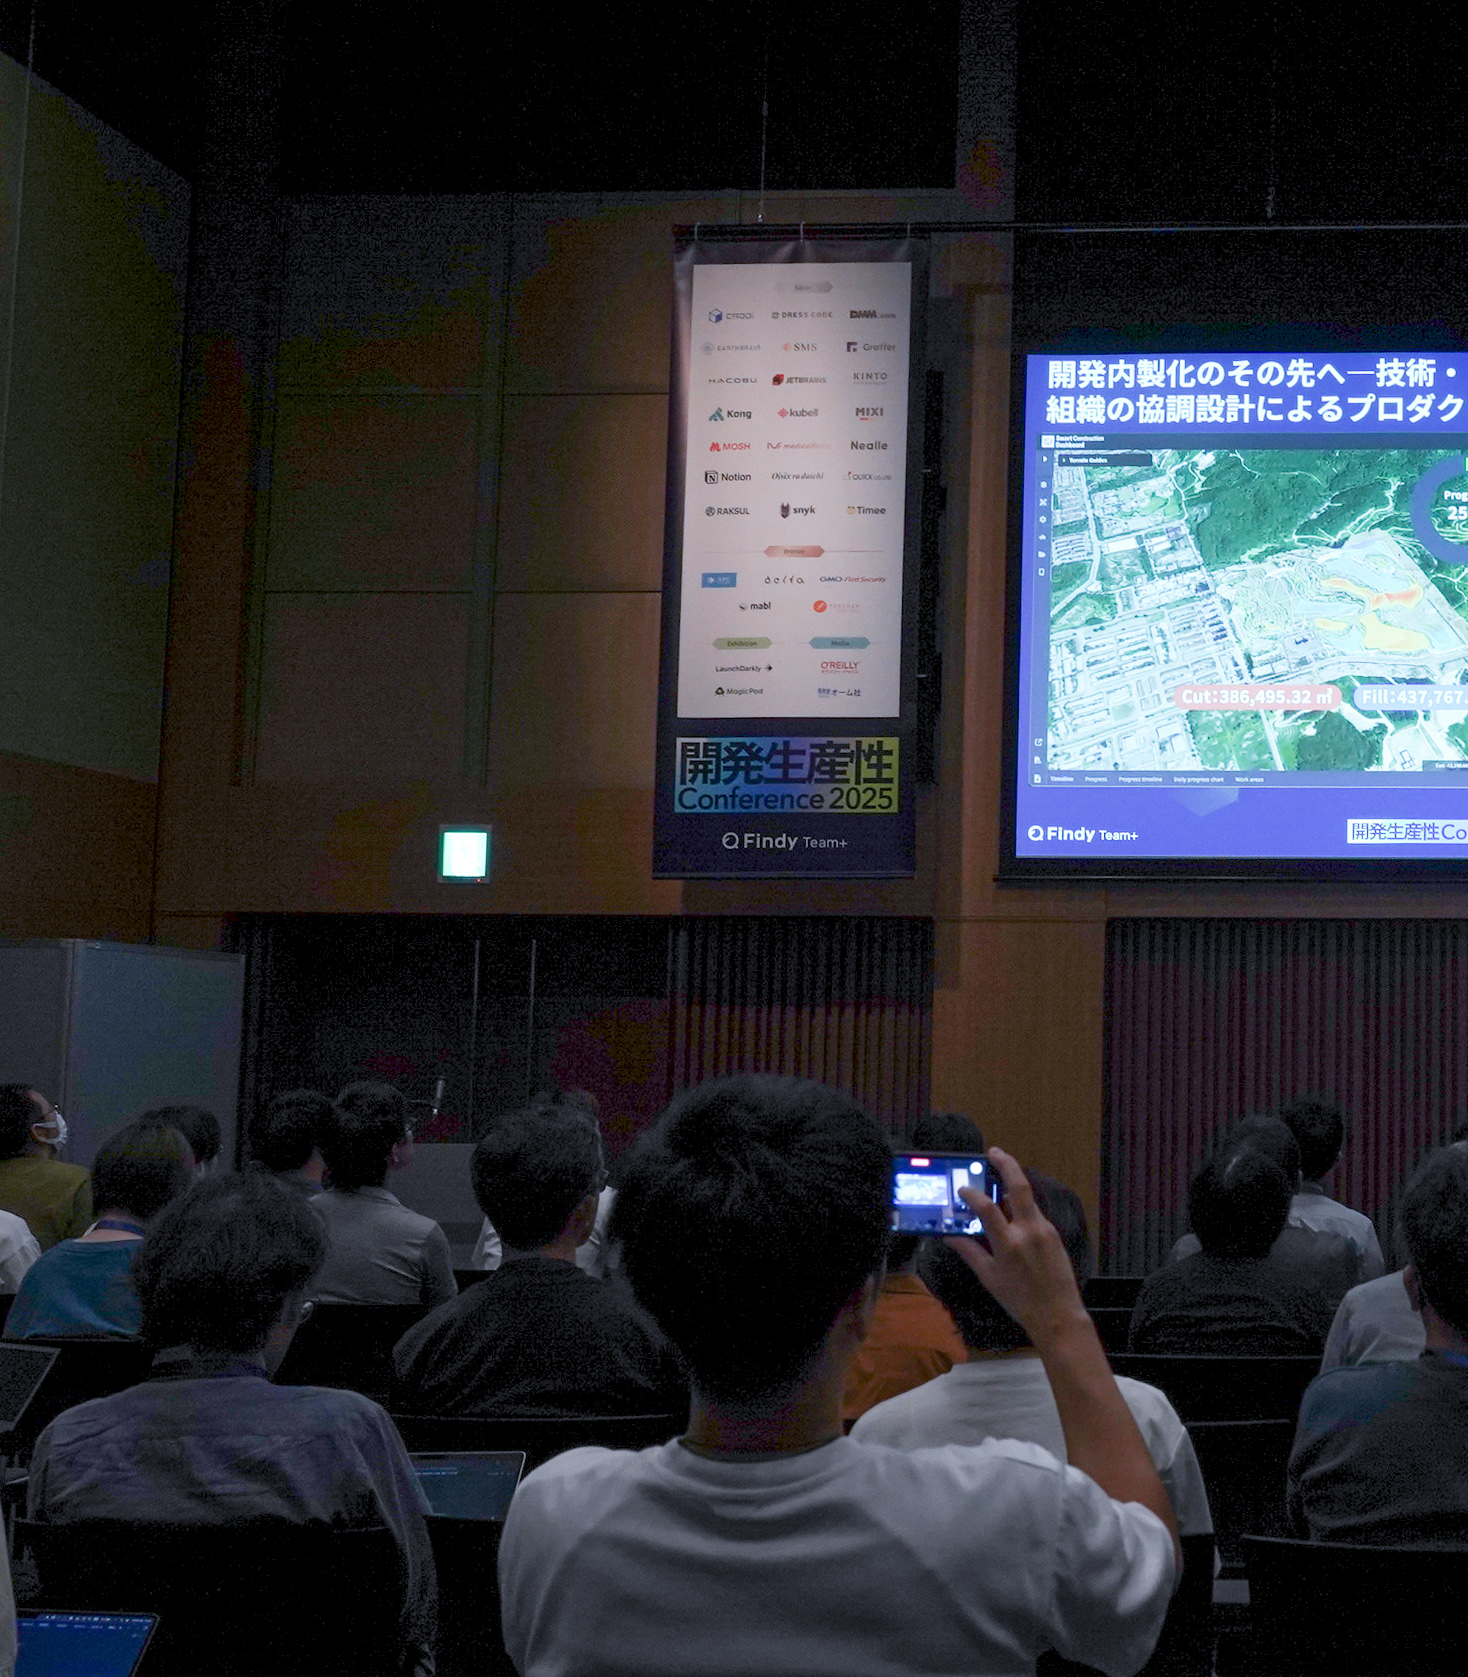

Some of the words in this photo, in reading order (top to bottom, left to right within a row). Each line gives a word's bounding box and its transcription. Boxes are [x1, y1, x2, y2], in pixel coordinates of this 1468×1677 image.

[794, 343, 817, 351] SMS
[853, 372, 888, 380] KINTO
[726, 410, 752, 419] Kong
[790, 408, 818, 417] kubell
[856, 408, 884, 416] MIXI
[851, 441, 888, 450] Nealle
[721, 472, 752, 482] Notion
[793, 506, 815, 516] snyk
[857, 506, 886, 515] Timee
[750, 602, 771, 610] mabl
[680, 740, 894, 785] 開発生産性
[678, 787, 824, 810] Conference
[829, 788, 893, 810] 2025
[1047, 827, 1096, 842] Findy
[1099, 830, 1138, 841] Team+
[744, 833, 798, 850] Findy
[803, 836, 848, 849] Team+
